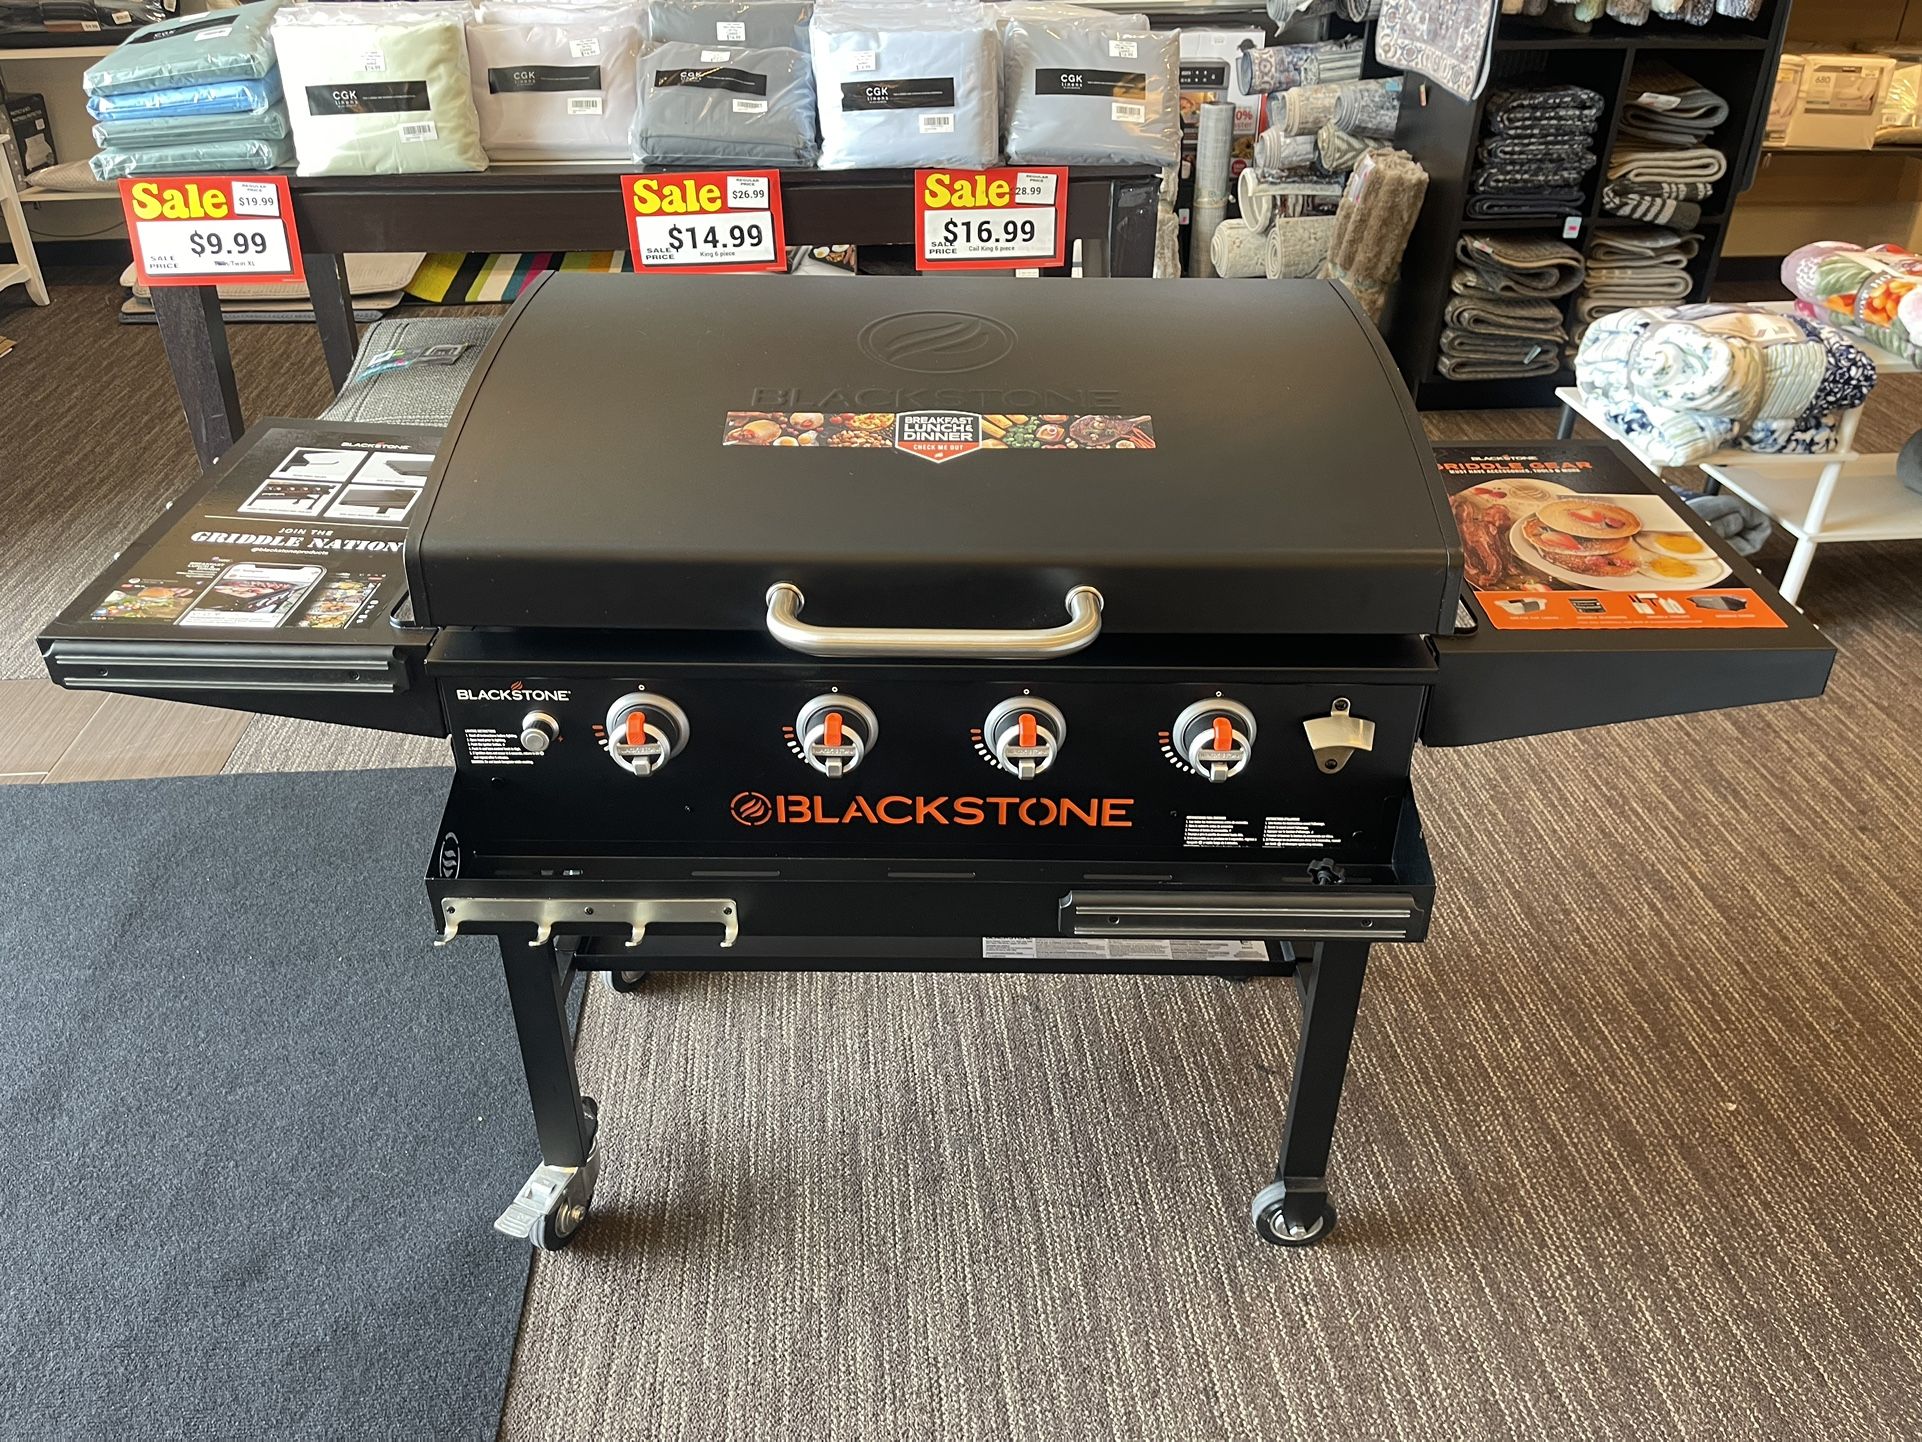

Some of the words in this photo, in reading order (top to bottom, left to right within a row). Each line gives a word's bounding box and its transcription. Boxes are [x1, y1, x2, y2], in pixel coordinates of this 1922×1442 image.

[513, 71, 536, 80] CGK
[1060, 73, 1083, 83] CGK
[332, 90, 358, 100] CGK
[865, 87, 889, 96] CGK
[1235, 110, 1253, 120] 0%
[732, 190, 765, 200] $26.99
[924, 173, 1011, 208] Sale
[131, 182, 229, 220] Sale
[633, 178, 722, 214] Sale
[239, 197, 274, 207] $19.99
[943, 217, 1035, 245] $16.99
[668, 223, 763, 253] $14.99
[190, 230, 267, 257] $9.99
[981, 245, 994, 253] King
[999, 245, 1015, 253] piece
[750, 386, 1121, 408] BLACKSTONE
[904, 416, 974, 424] BREAKFAST
[903, 432, 973, 441] DINNER
[341, 441, 411, 450] BLACKSTONE
[1529, 461, 1593, 469] GEAR
[278, 527, 306, 535] JOIN
[190, 531, 304, 547] GRIDDLE
[307, 537, 405, 552] NATION
[250, 547, 329, 556] @blackstoneproducts
[456, 689, 570, 701] BLACKSTONE
[776, 795, 1134, 827] BLACKSTONE
